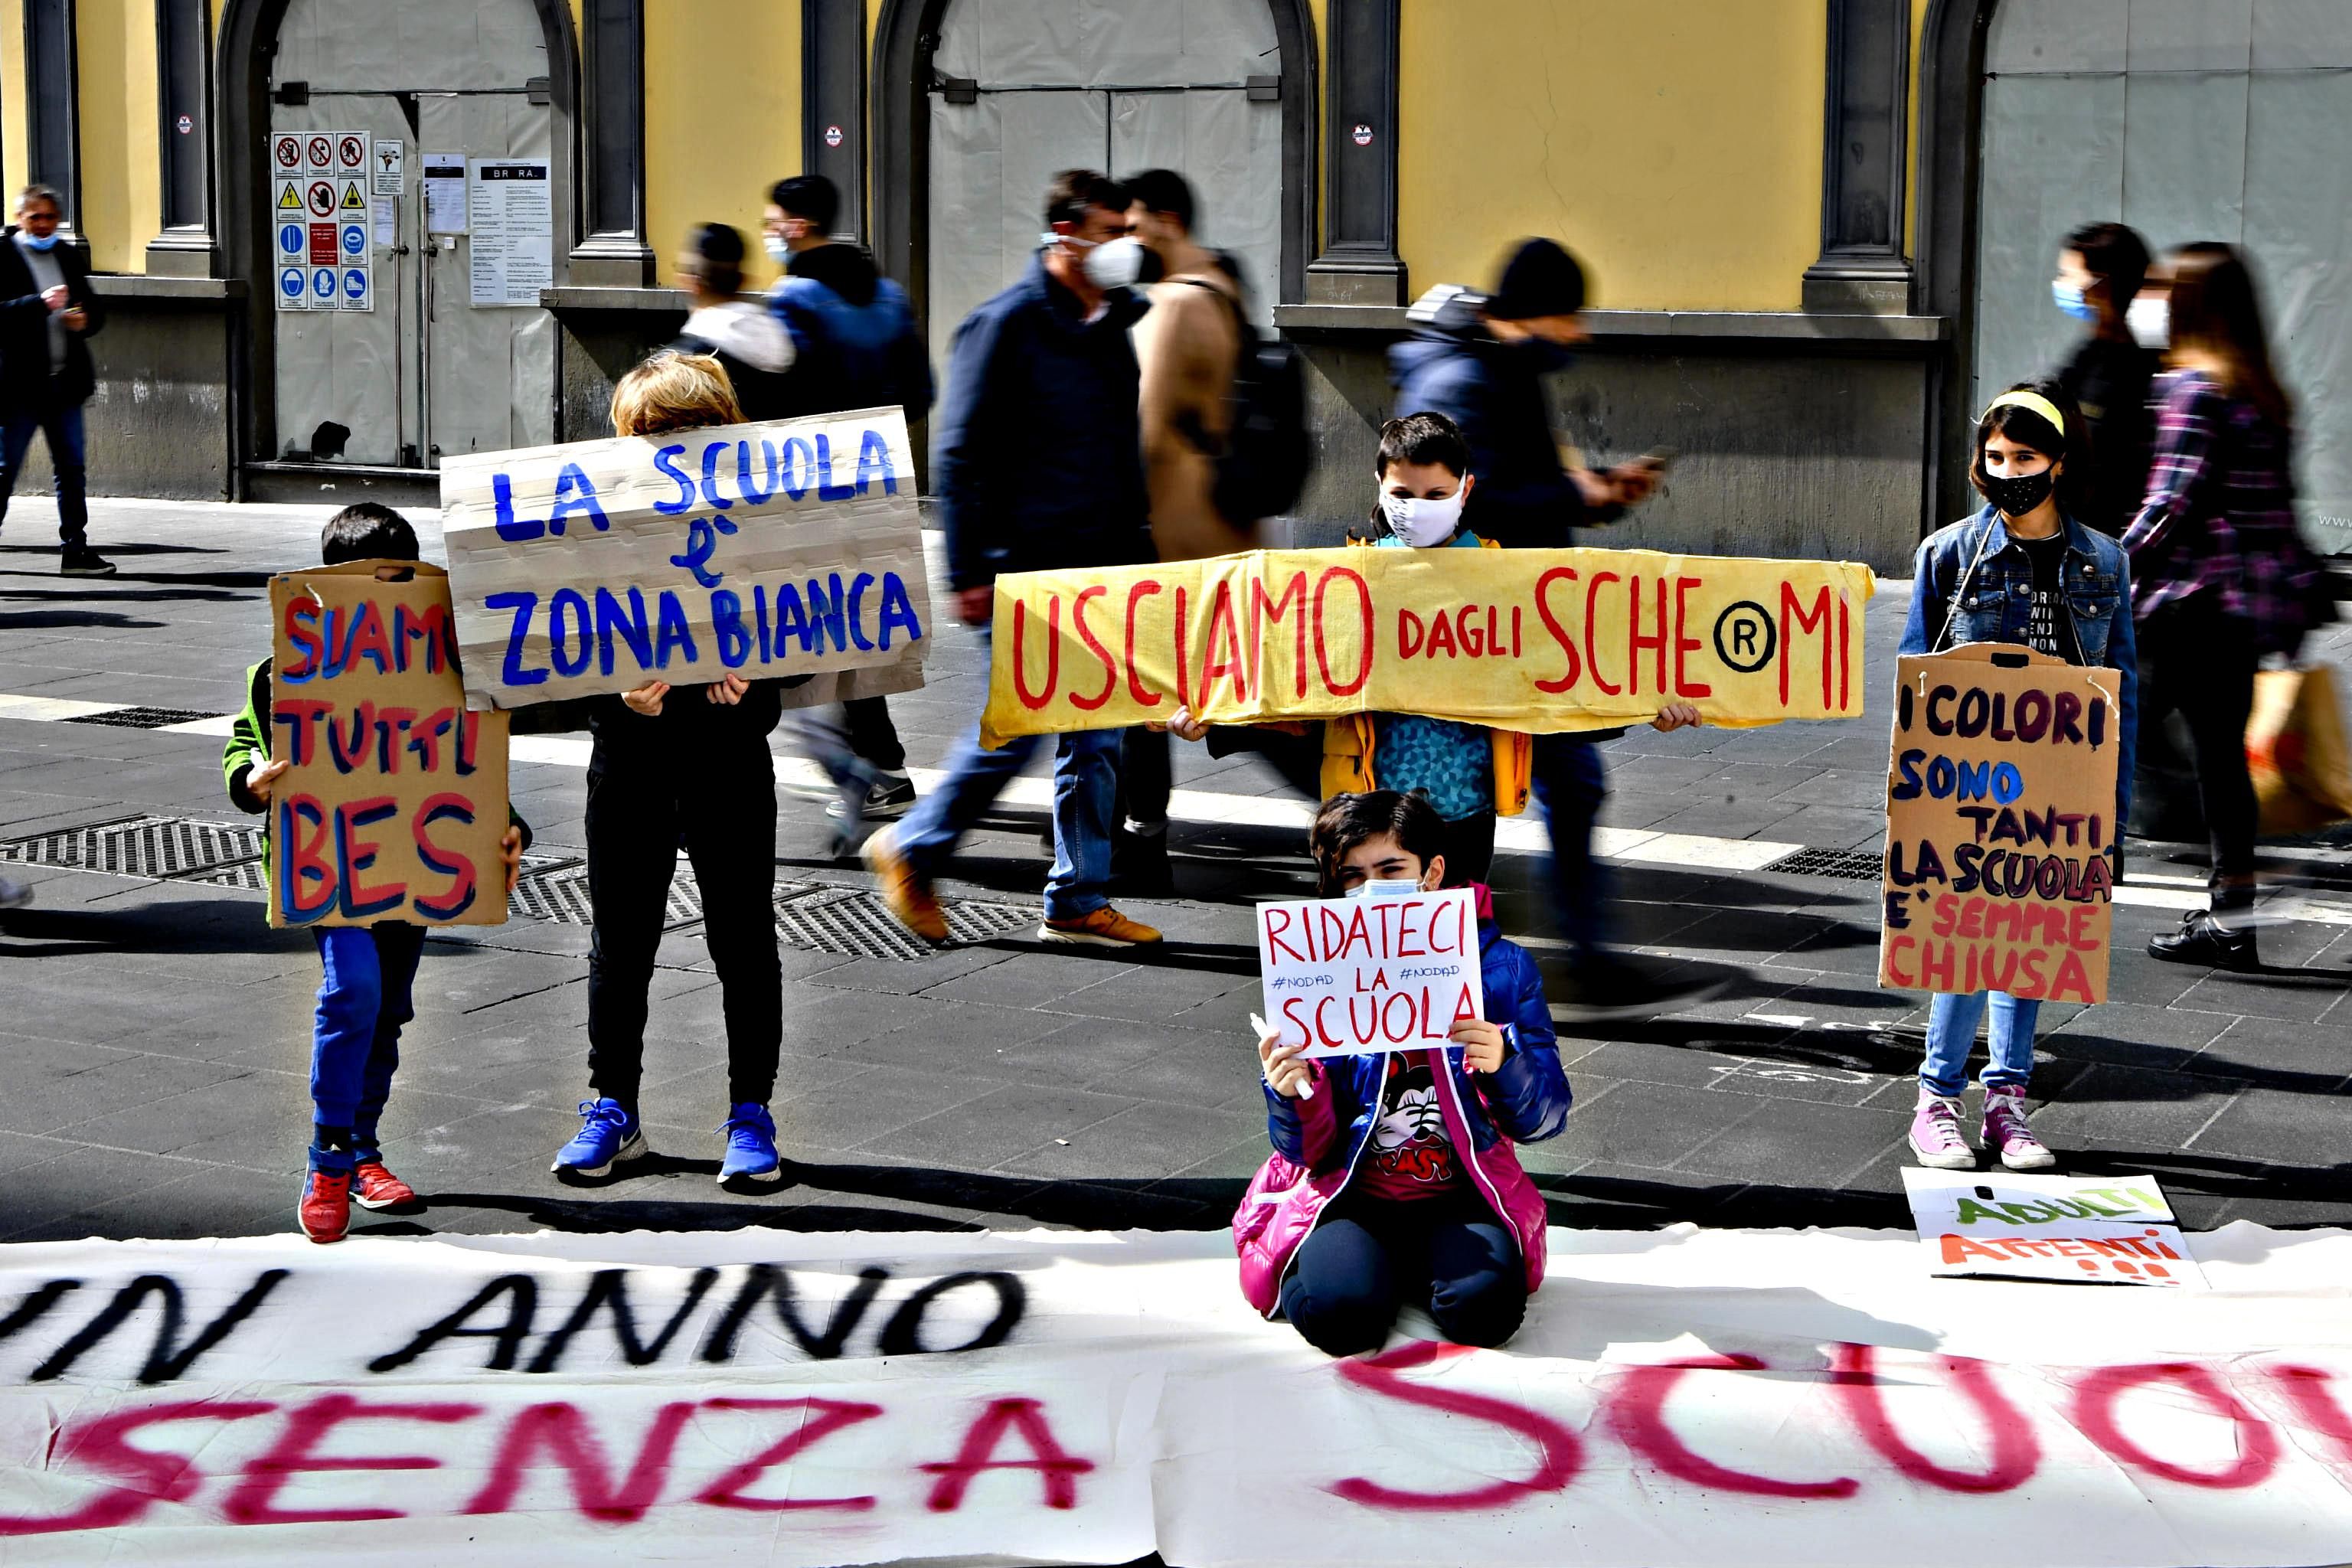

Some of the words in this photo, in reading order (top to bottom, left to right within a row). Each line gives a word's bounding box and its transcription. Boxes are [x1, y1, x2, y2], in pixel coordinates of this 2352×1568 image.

[493, 462, 609, 542] LA
[653, 430, 899, 514] SCUOLA
[485, 586, 699, 687] ZONA
[710, 571, 922, 668] BIANCA
[1013, 566, 1374, 710] USCIAMO
[1399, 604, 1521, 660] DAGLI
[274, 698, 479, 776] TUTTI
[1899, 684, 1913, 732] I
[1926, 684, 2105, 751] COLORI
[1892, 749, 2025, 805] SONO
[280, 792, 476, 924] BES
[1957, 805, 2102, 848] TANTI
[1890, 840, 1947, 886] LA
[1265, 900, 1465, 965] RIDATECI
[1932, 893, 2100, 951] SEMPRE
[1270, 975, 1334, 990] #NODAD
[1357, 967, 1389, 992] LA
[1400, 965, 1460, 980] #NODAD
[1888, 936, 2096, 1004] CHIUSA
[1279, 982, 1475, 1050] SCUOLA
[1956, 1187, 2167, 1225] ADULTI
[368, 1265, 1027, 1374] ANNO
[0, 1393, 1095, 1536] SENZA
